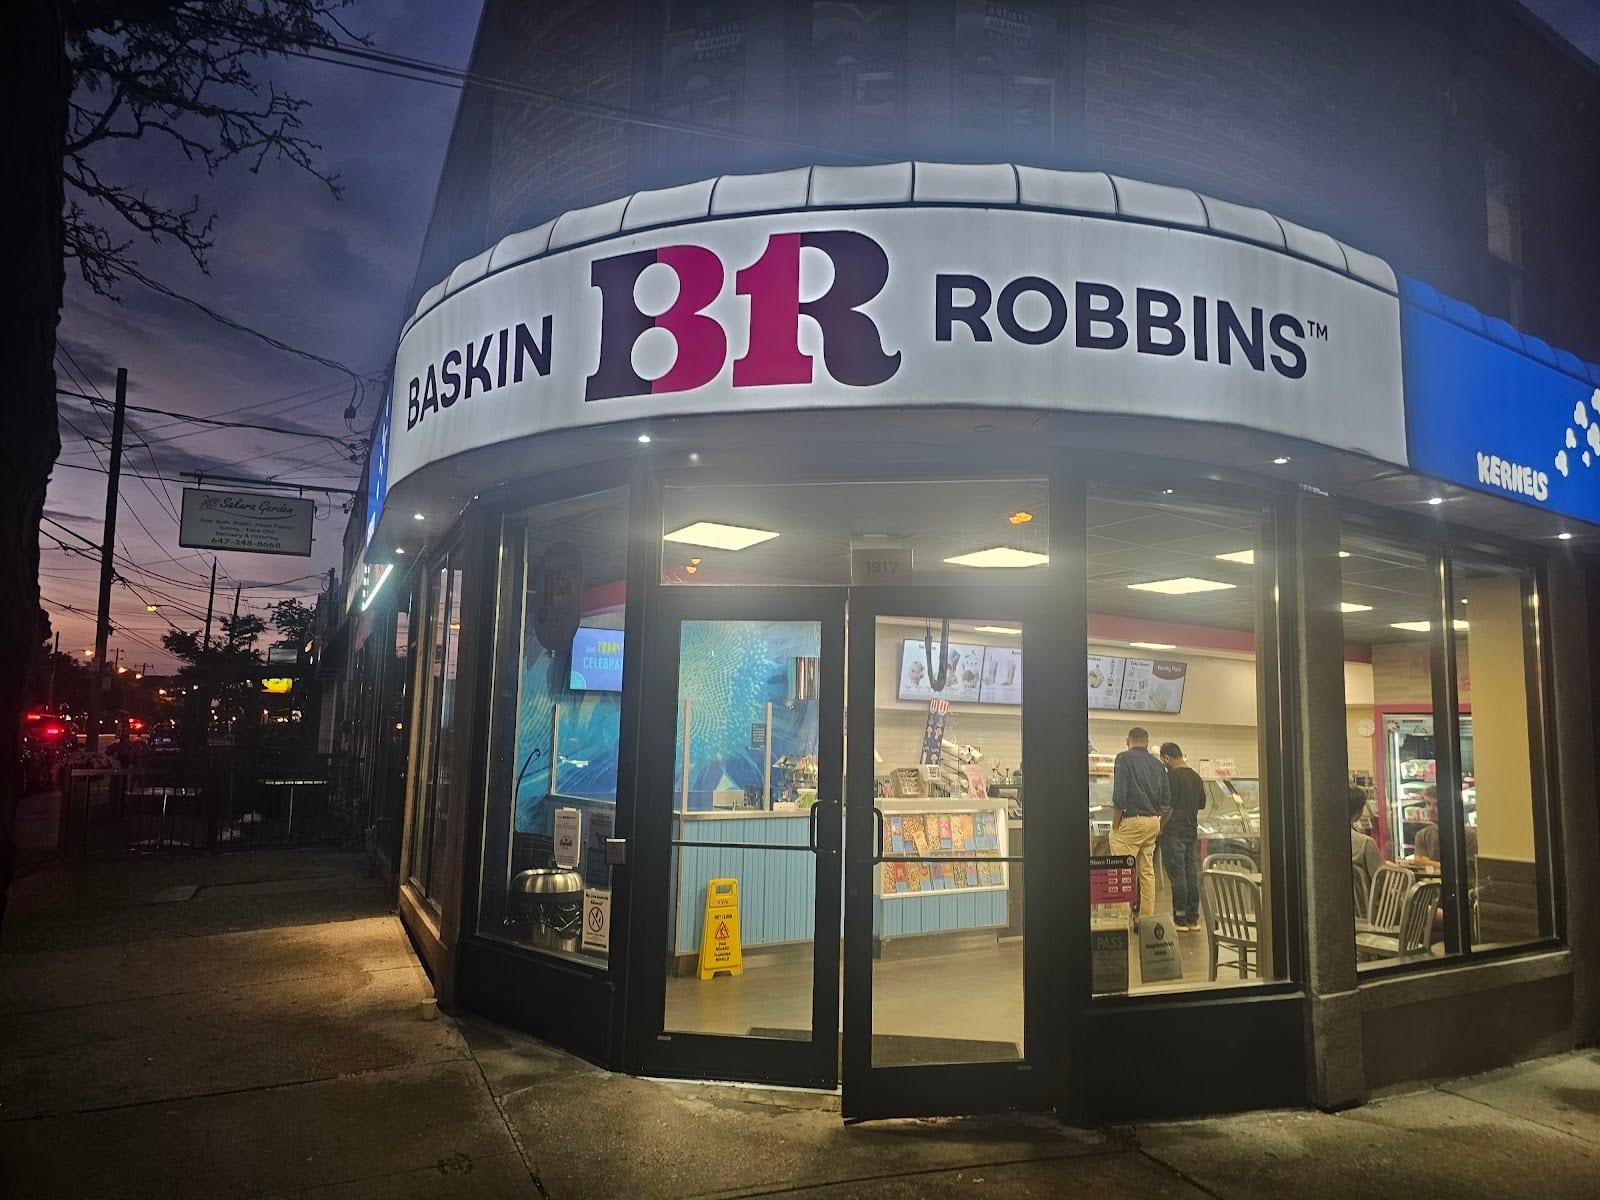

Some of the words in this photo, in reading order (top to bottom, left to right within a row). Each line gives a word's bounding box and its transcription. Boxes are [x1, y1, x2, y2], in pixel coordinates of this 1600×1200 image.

[584, 229, 902, 402] BR
[406, 313, 554, 432] BASKIN
[1476, 450, 1549, 502] KERNELS
[258, 500, 294, 515] Garden
[865, 560, 899, 575] 1917
[583, 656, 621, 670] CELEBRA
[1097, 935, 1123, 949] PASS
